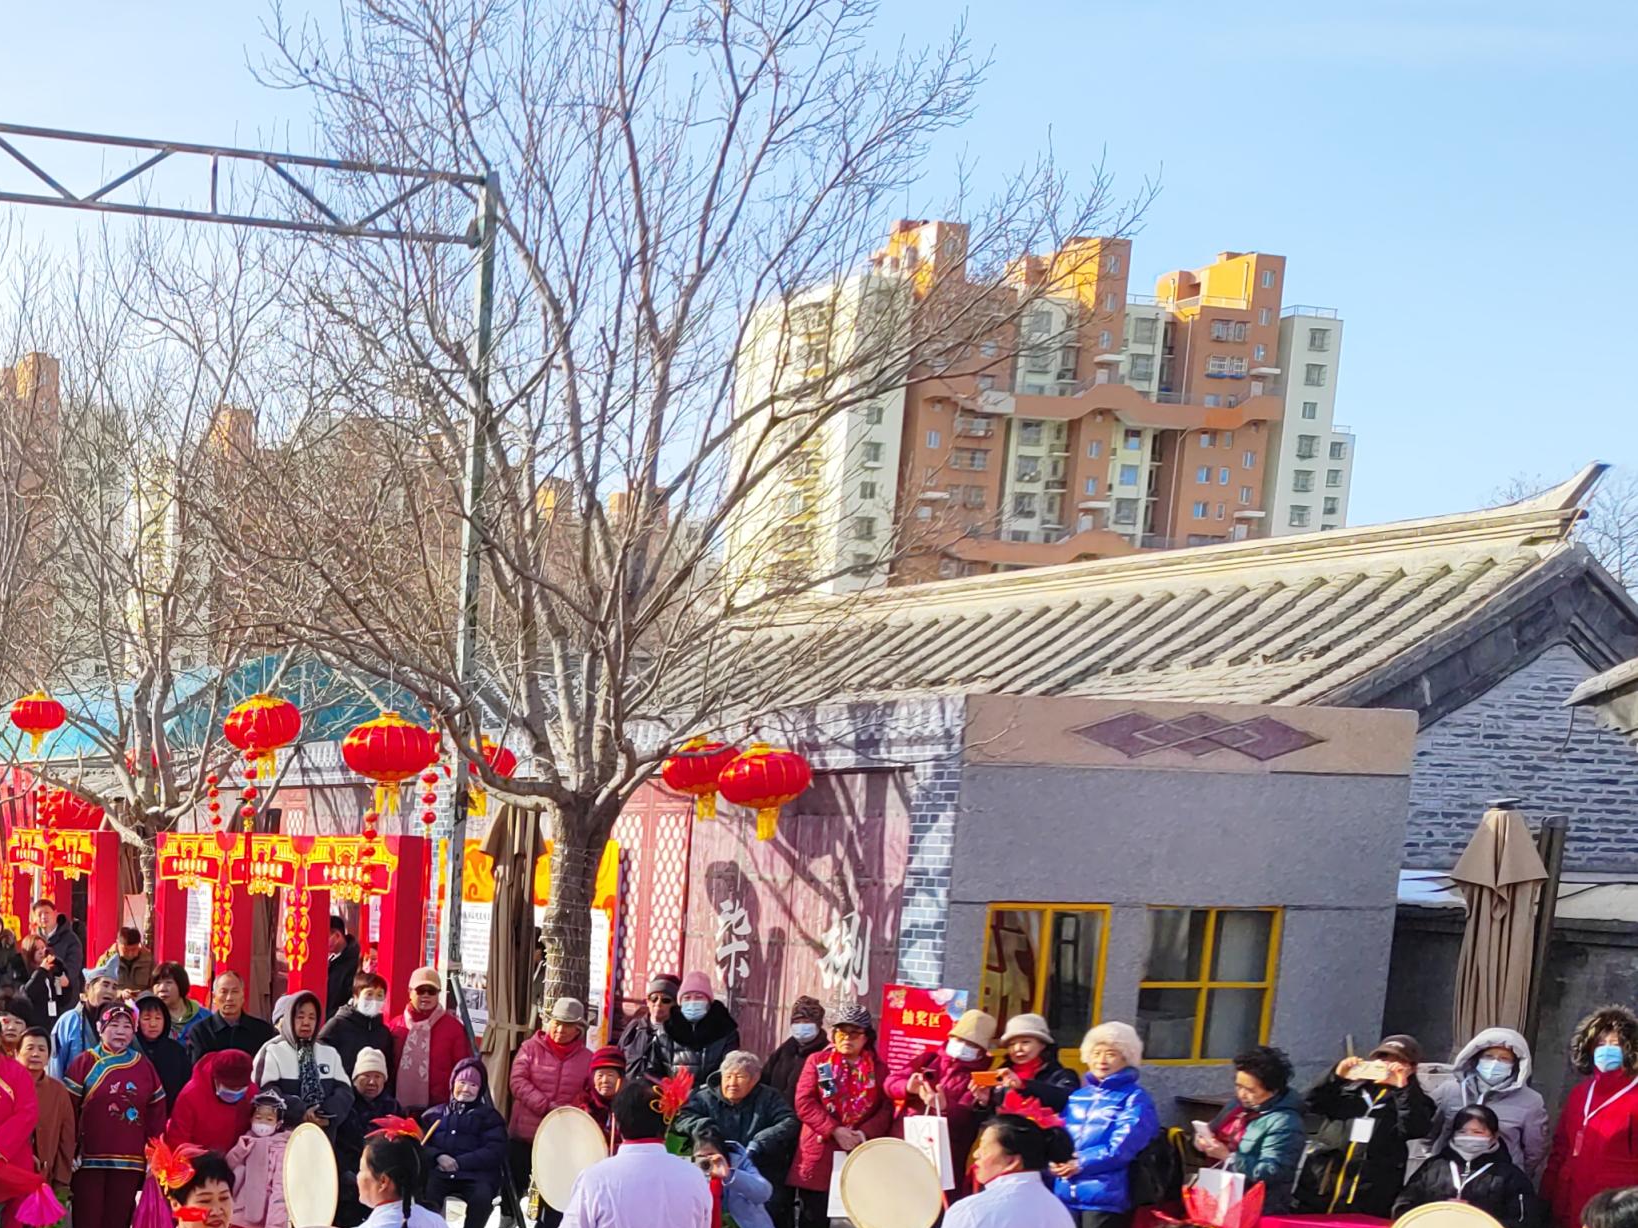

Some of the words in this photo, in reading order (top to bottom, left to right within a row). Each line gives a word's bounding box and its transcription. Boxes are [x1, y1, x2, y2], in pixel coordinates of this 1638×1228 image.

[715, 899, 752, 988] 柒
[902, 1008, 941, 1028] 抽奖区
